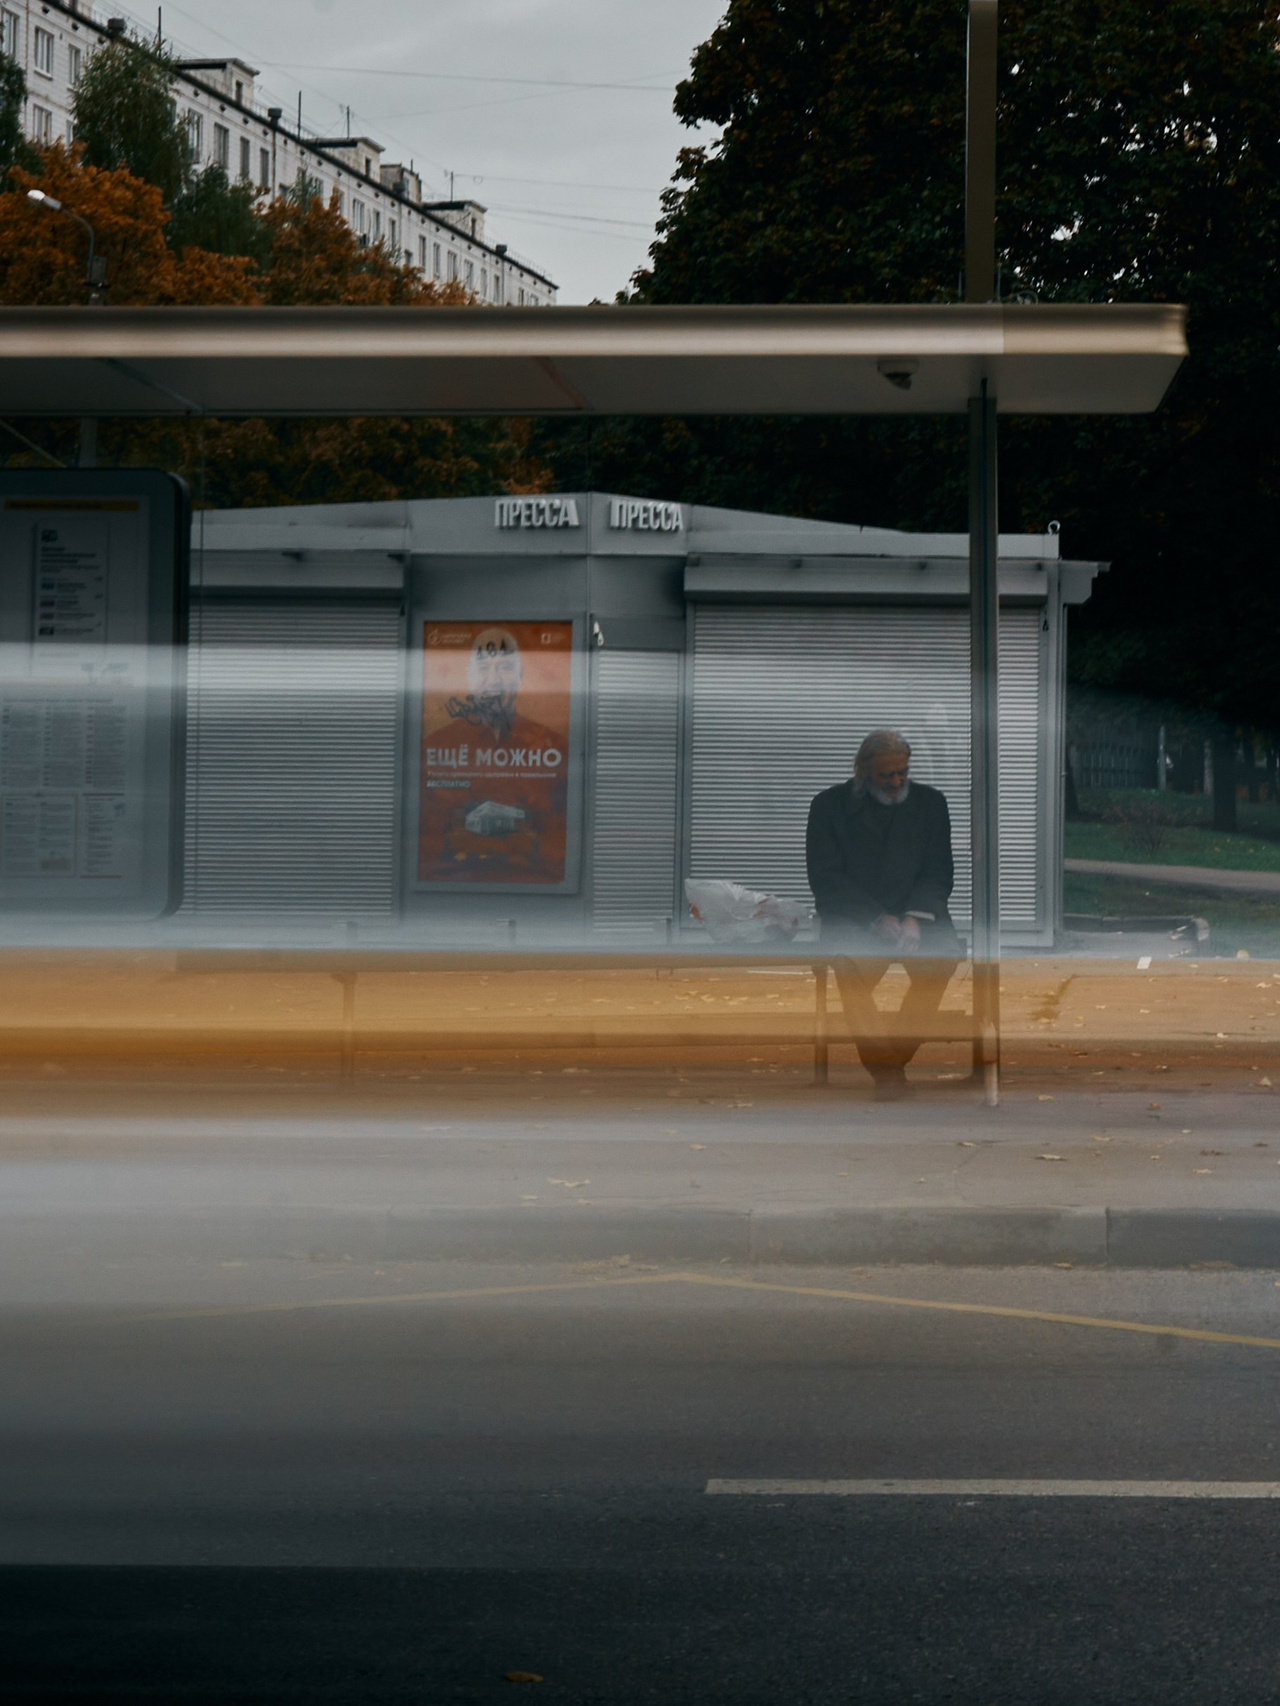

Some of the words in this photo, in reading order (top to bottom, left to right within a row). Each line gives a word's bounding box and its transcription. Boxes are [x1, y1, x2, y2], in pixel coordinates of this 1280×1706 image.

[495, 499, 579, 527] ПРЕССА
[610, 500, 684, 530] ПРЕССА
[426, 744, 469, 769] ЕЩЁ
[475, 748, 562, 767] МОЖНО
